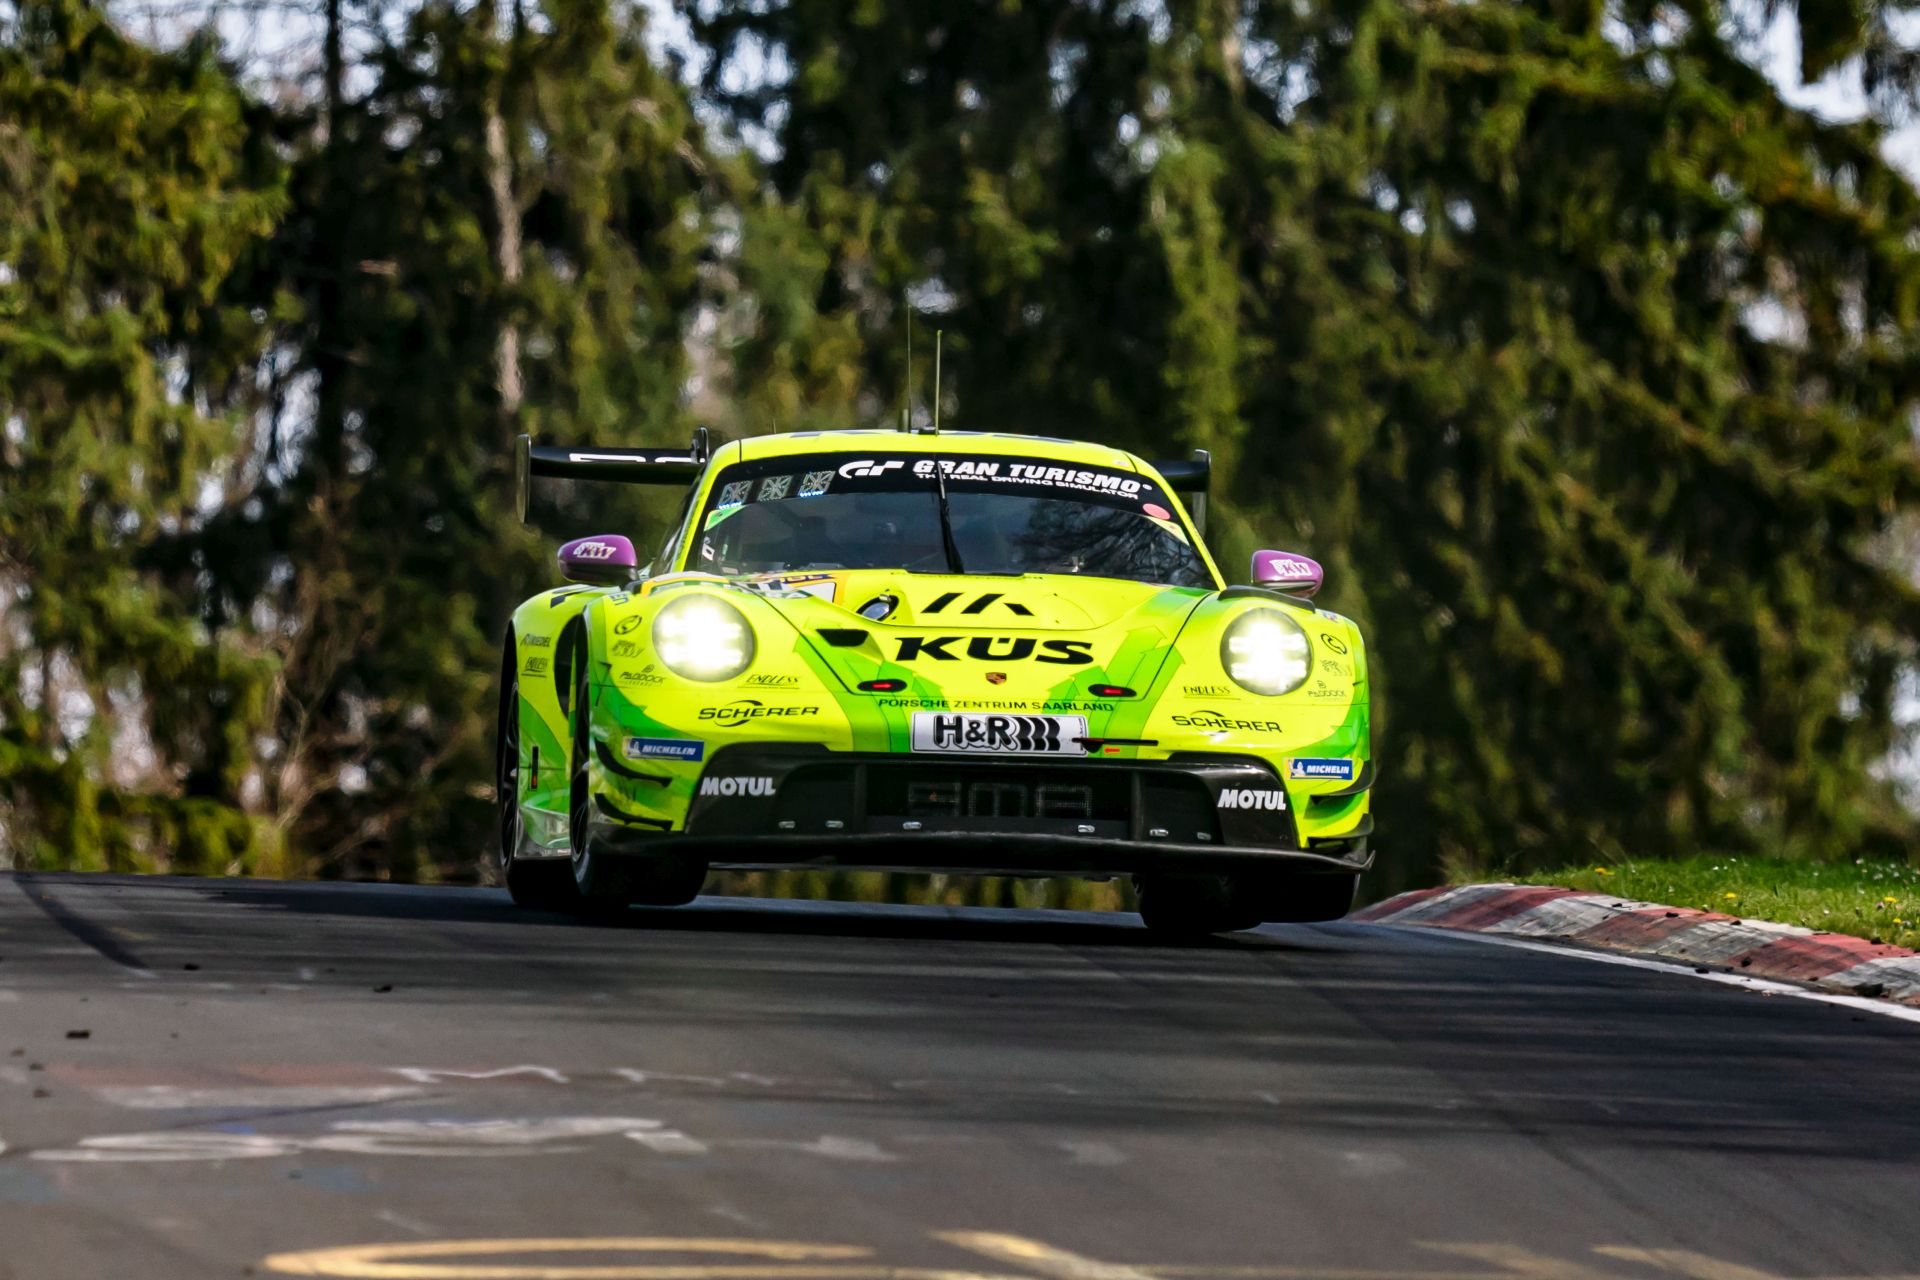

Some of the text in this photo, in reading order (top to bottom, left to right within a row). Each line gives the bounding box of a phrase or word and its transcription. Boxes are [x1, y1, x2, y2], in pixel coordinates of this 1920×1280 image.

[913, 460, 999, 476] GRAN
[950, 474, 988, 482] REAL
[991, 476, 1053, 486] DRIVING
[1055, 482, 1139, 500] SIMULATOR
[895, 636, 1094, 665] KÜS
[745, 675, 799, 685] ENDLESS
[698, 706, 819, 720] SCHERER
[878, 698, 1114, 712] PORSCHE ZENTRUM SAARLAND
[933, 714, 1018, 751] H&R
[1171, 715, 1282, 733] SCHERER
[642, 745, 696, 755] MICHELIN
[1306, 764, 1350, 775] MICHELIN
[701, 777, 776, 796] MOTUL
[1217, 788, 1286, 811] MOTUL
